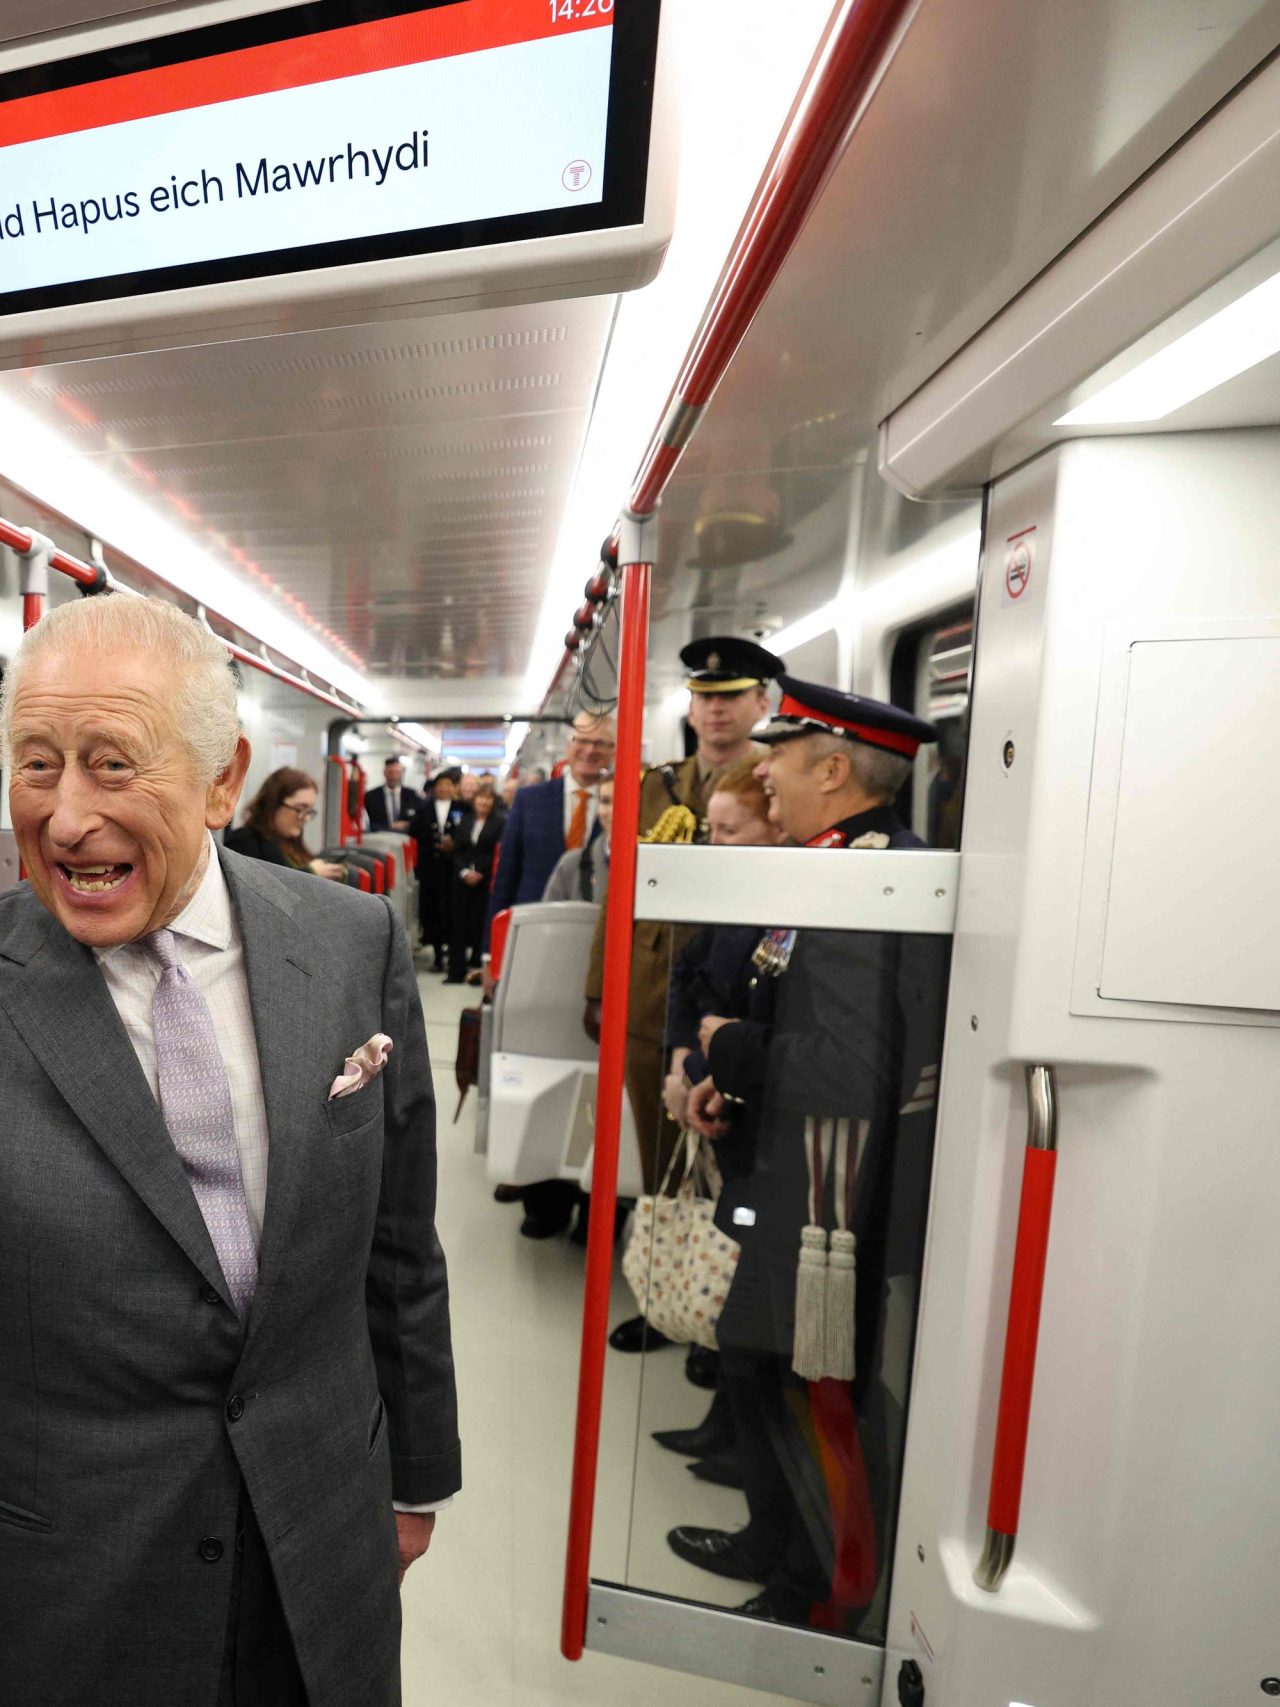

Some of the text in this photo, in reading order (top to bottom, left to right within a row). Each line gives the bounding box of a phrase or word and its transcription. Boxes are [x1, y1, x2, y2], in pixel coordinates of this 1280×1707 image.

[32, 191, 140, 234] Hapus
[149, 168, 224, 212] eich
[235, 129, 429, 198] Mawrhydi
